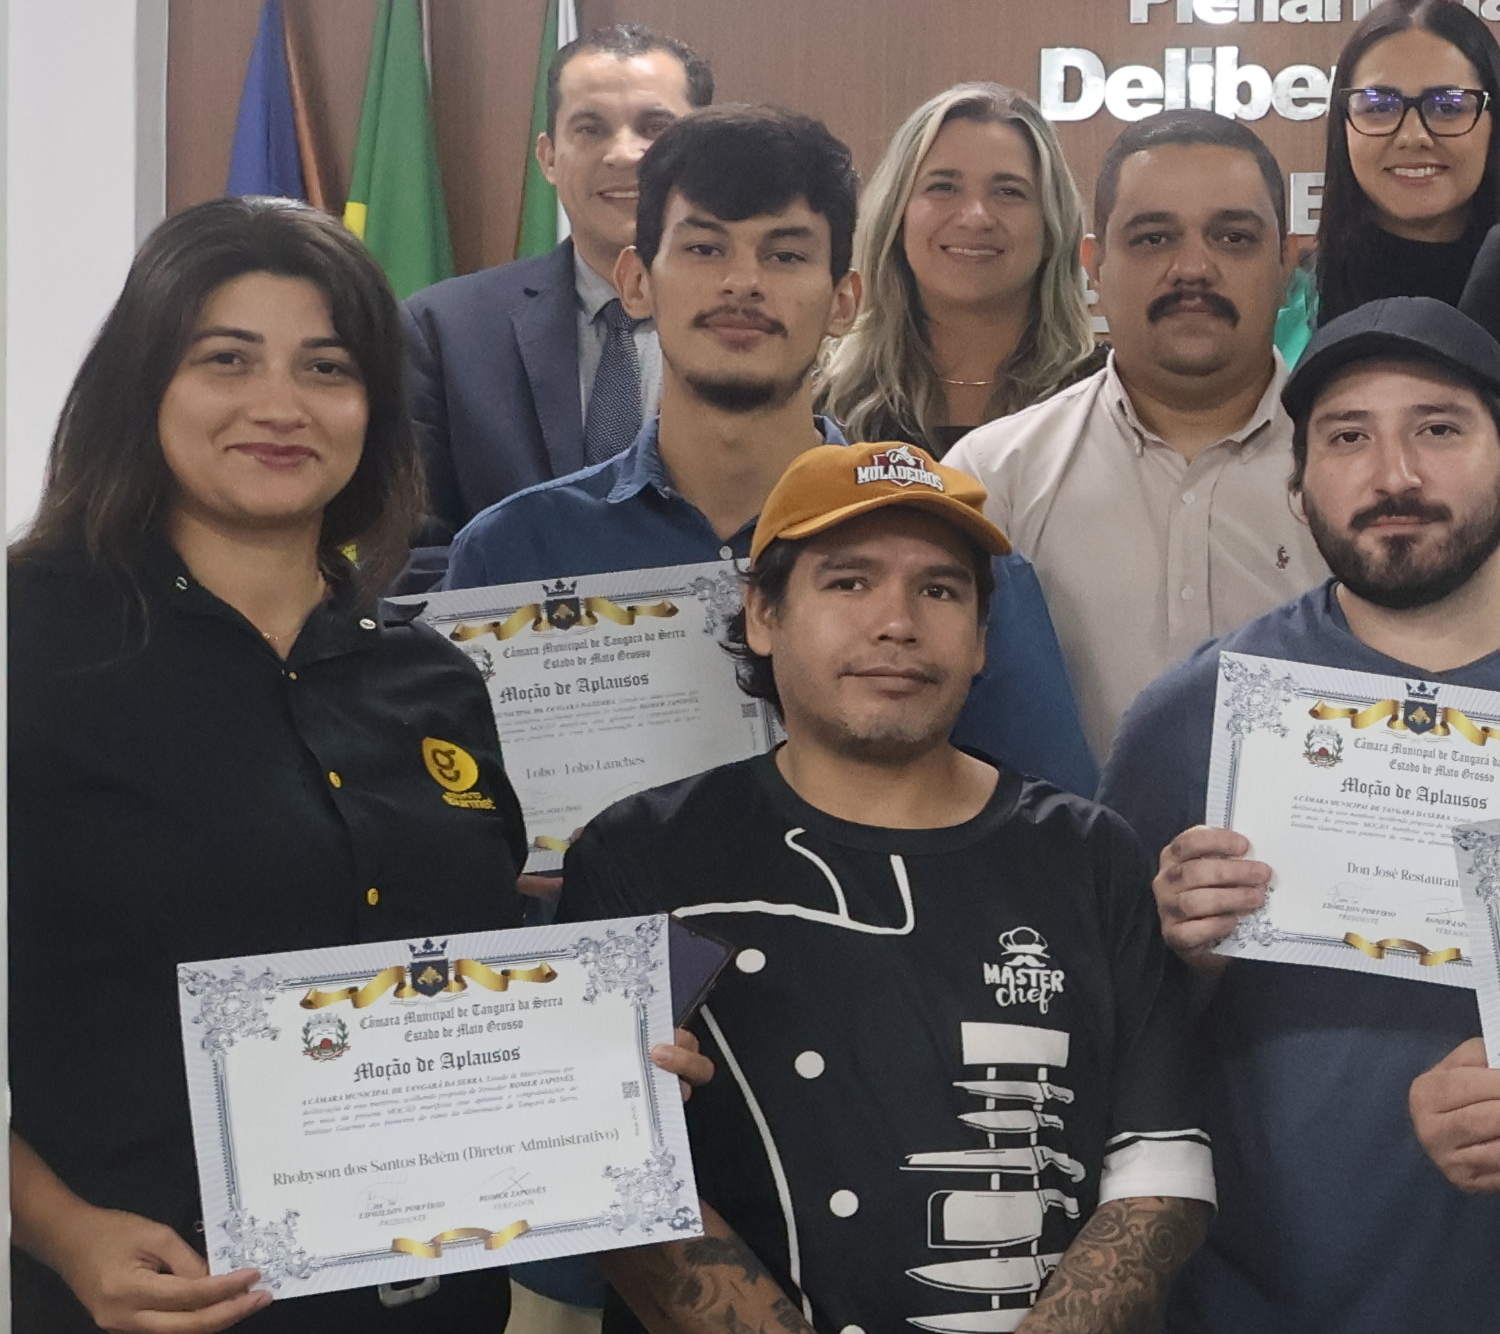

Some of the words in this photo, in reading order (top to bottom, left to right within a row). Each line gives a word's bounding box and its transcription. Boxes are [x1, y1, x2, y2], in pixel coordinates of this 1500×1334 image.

[857, 465, 944, 491] MULADEIROS
[499, 682, 551, 704] Moção
[554, 681, 572, 696] de
[575, 673, 650, 694] Aplausos
[1339, 776, 1391, 799] Moção
[1395, 784, 1412, 800] de
[1416, 785, 1488, 810] Aplausos
[1347, 861, 1370, 876] Don
[1372, 865, 1399, 880] José
[983, 962, 1064, 992] MASTER
[996, 984, 1054, 1014] chef
[353, 1058, 411, 1083] Moção
[415, 1056, 435, 1073] de
[439, 1046, 521, 1071] Aplausos
[272, 1168, 342, 1187] Rhobyson
[343, 1163, 368, 1177] dos
[370, 1158, 417, 1172] Santos
[462, 1144, 516, 1162] (Diretor
[520, 1127, 619, 1152] Administrativo)
